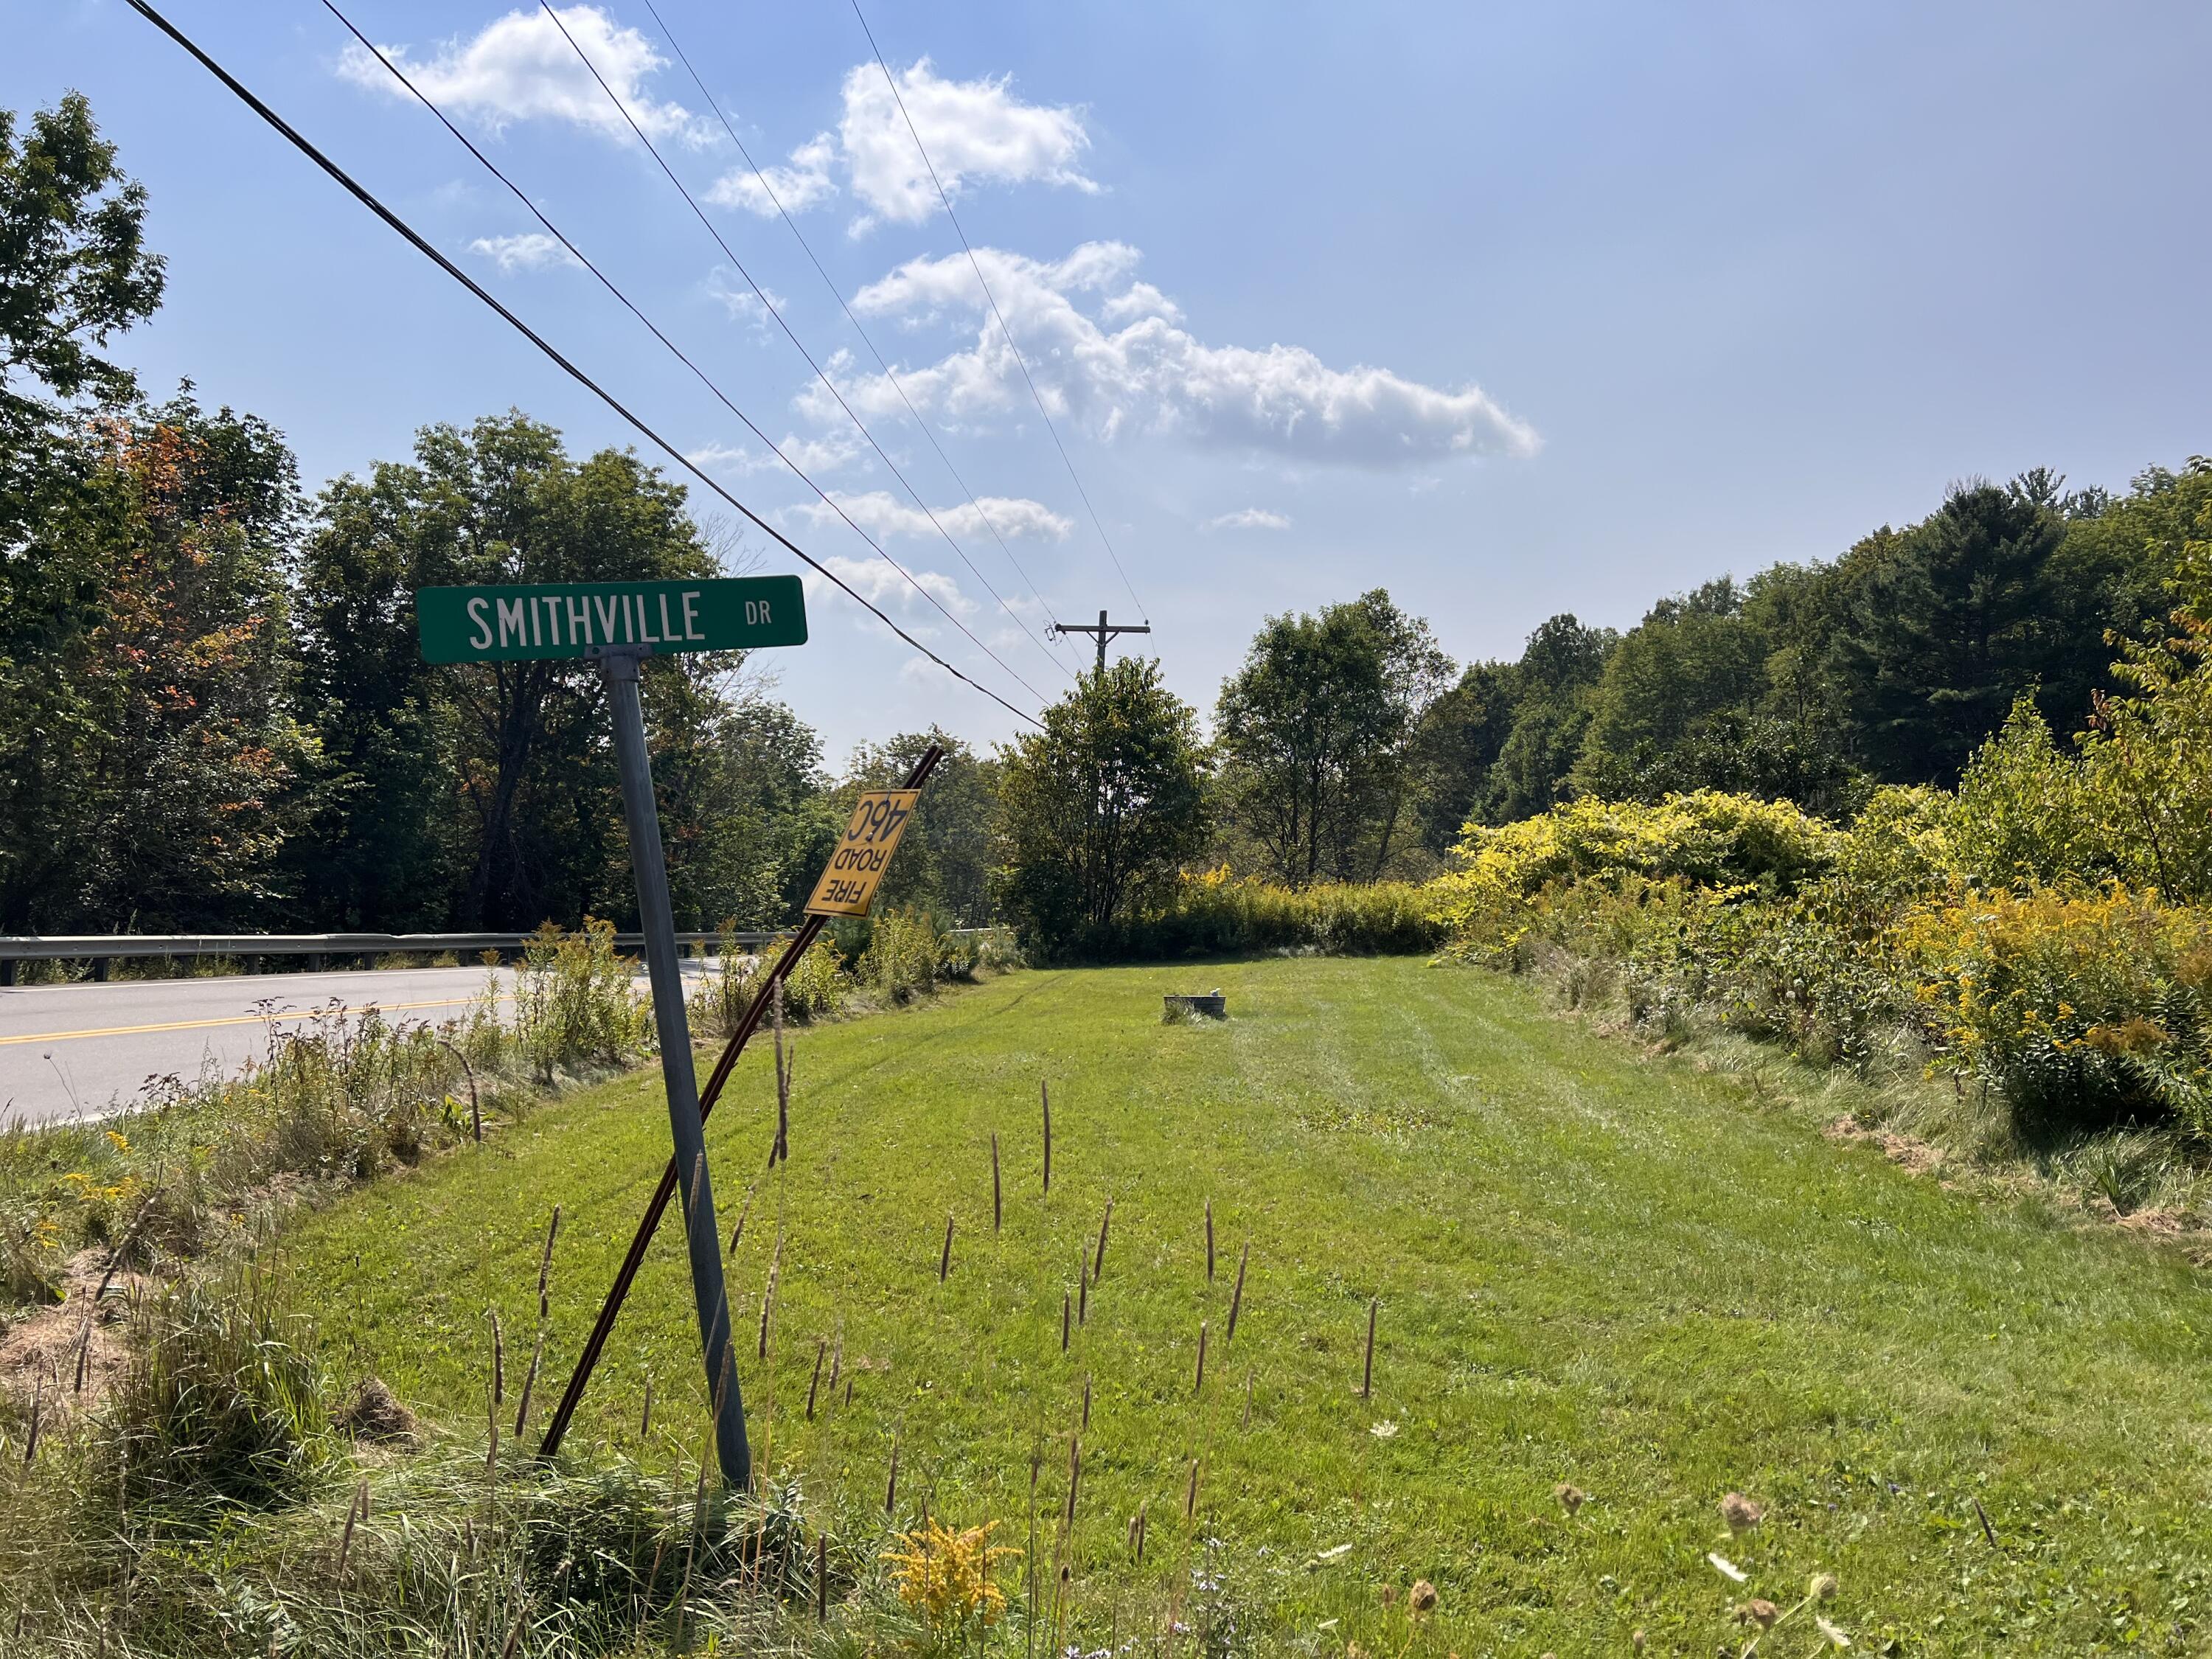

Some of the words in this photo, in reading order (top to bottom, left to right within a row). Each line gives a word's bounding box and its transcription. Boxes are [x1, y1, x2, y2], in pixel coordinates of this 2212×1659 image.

[467, 591, 705, 650] SMITHVILLE
[745, 600, 772, 625] DR
[848, 799, 908, 842] 46C
[835, 848, 887, 872] ROAD
[821, 880, 867, 904] FIRE
